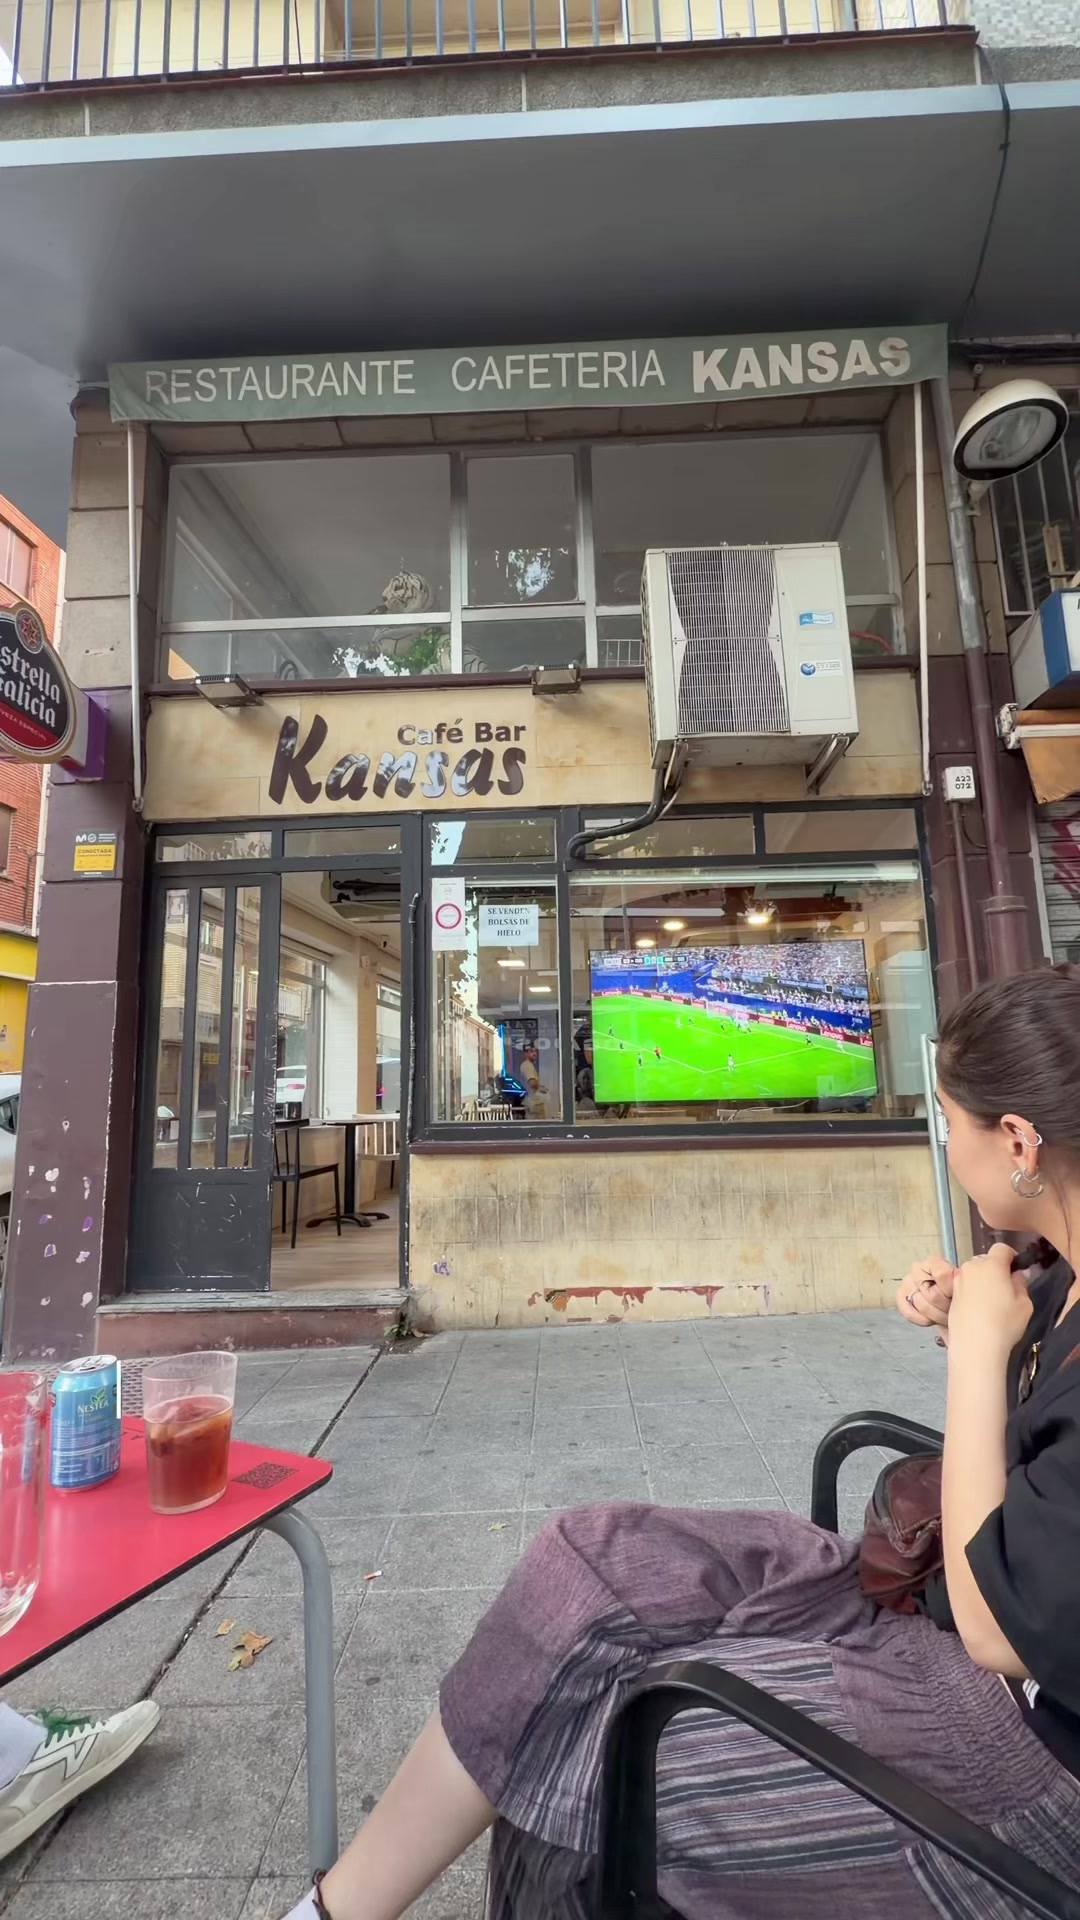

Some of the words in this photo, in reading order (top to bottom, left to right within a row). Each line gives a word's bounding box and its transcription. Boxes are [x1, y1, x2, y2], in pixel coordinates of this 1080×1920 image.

[145, 359, 416, 406] RESTAURANTE
[451, 349, 666, 393] CAFETERIA
[692, 337, 911, 394] KANSAS
[0, 645, 60, 704] strella
[397, 718, 464, 746] Café
[474, 721, 526, 743] Bar
[268, 714, 526, 805] Kansas
[820, 1028, 844, 1040] Lenovo
[77, 1400, 109, 1415] NESTEA
